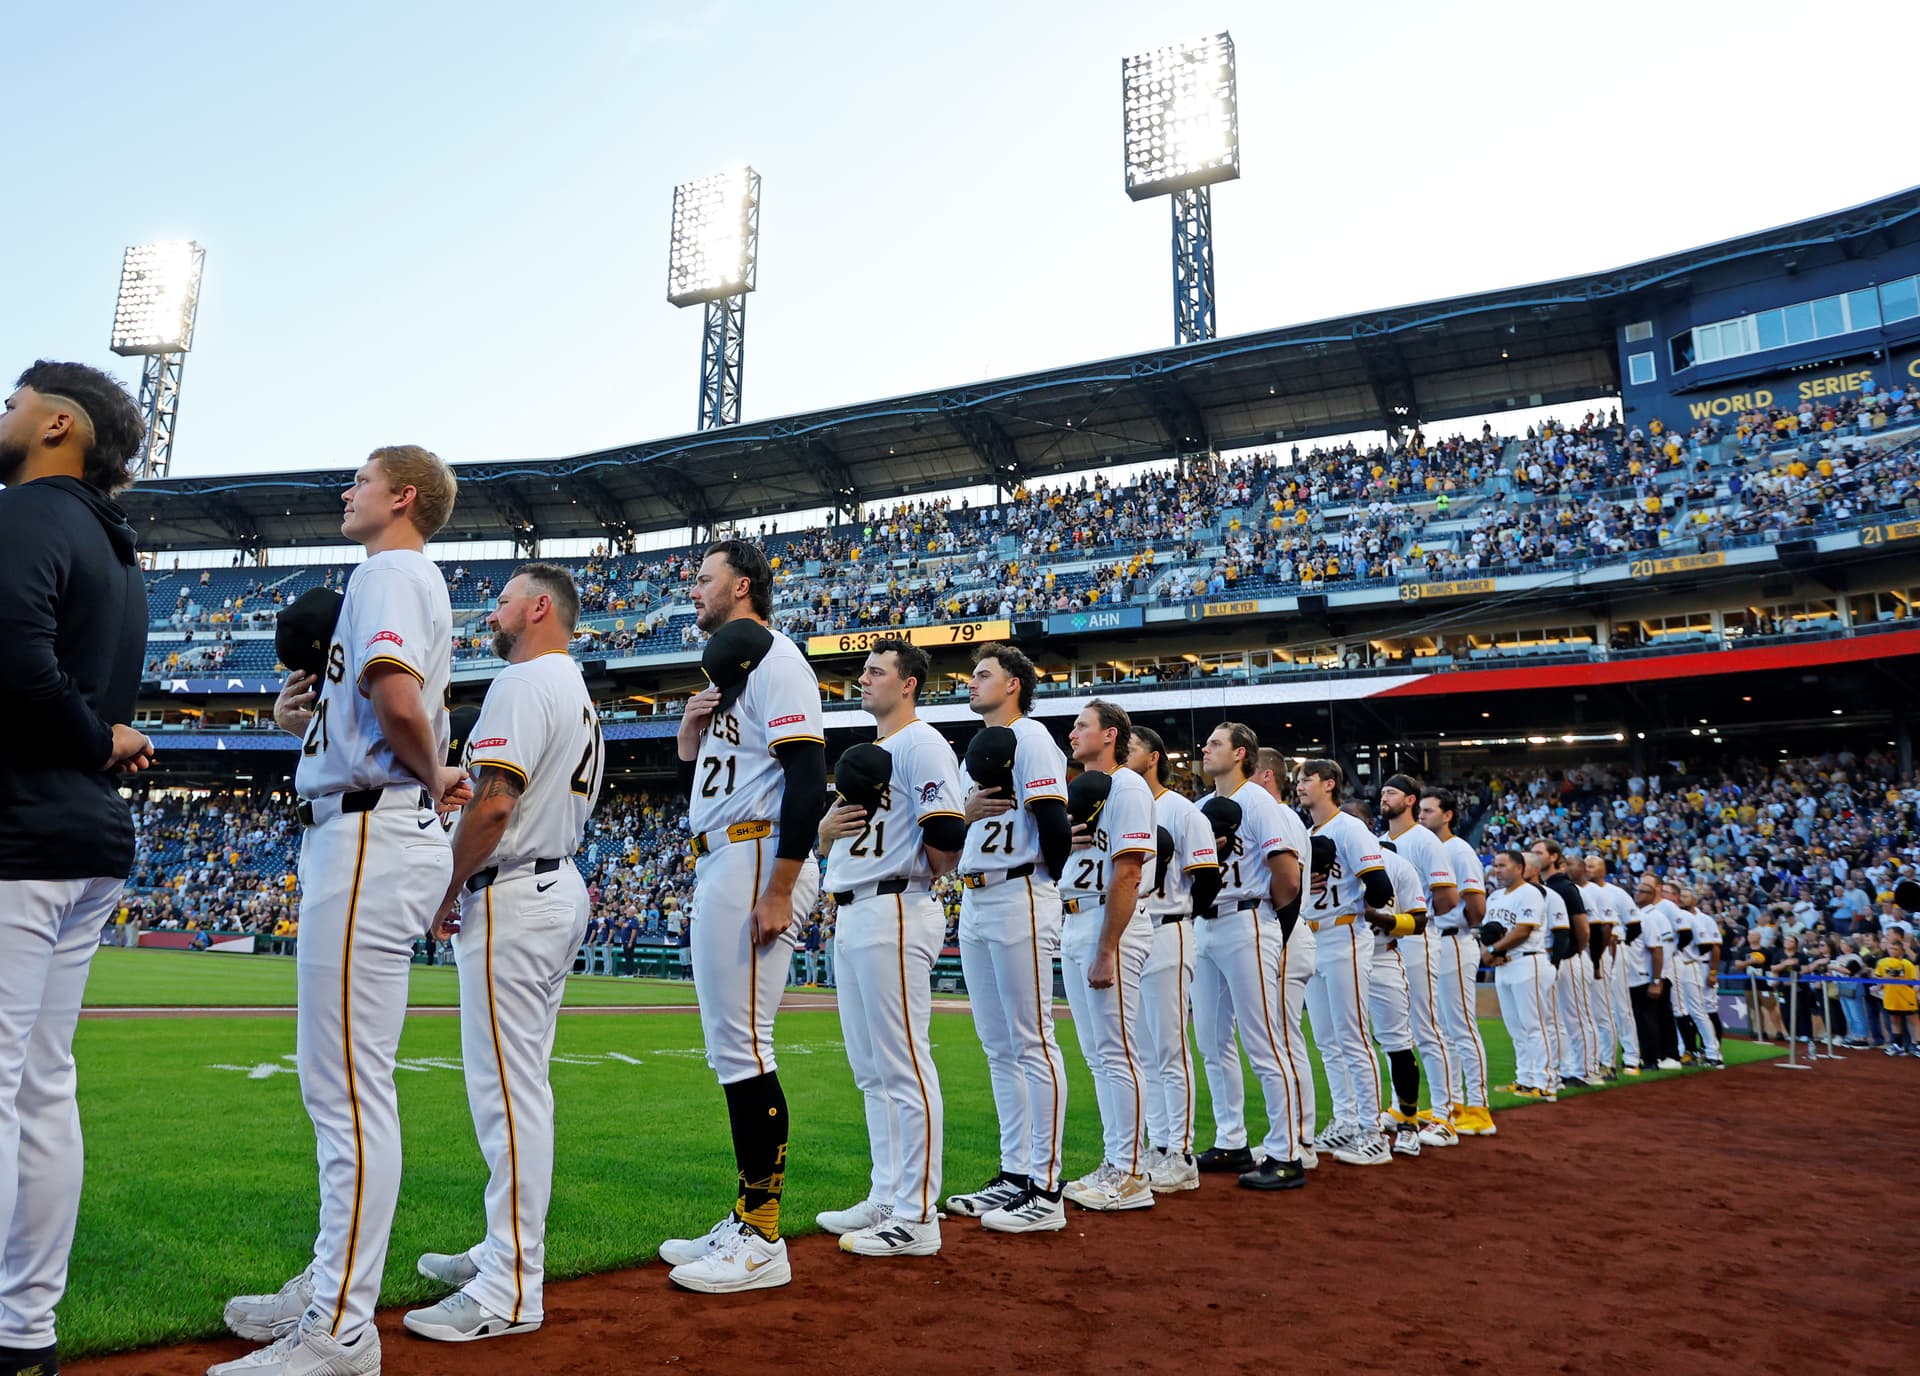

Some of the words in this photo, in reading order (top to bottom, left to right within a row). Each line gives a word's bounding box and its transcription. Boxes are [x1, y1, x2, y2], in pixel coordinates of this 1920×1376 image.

[1689, 390, 1773, 420] WORLD
[1862, 526, 1882, 545] 21
[1631, 560, 1653, 577] 20
[1400, 584, 1420, 600] 33
[1088, 613, 1120, 628] AHN
[770, 715, 804, 728] SHEETZ
[702, 755, 737, 798] 21
[1027, 778, 1056, 788] SHEETZ
[849, 820, 885, 858] 21
[980, 821, 1015, 855] 21
[1073, 859, 1104, 891] 21
[1314, 884, 1340, 911] 21
